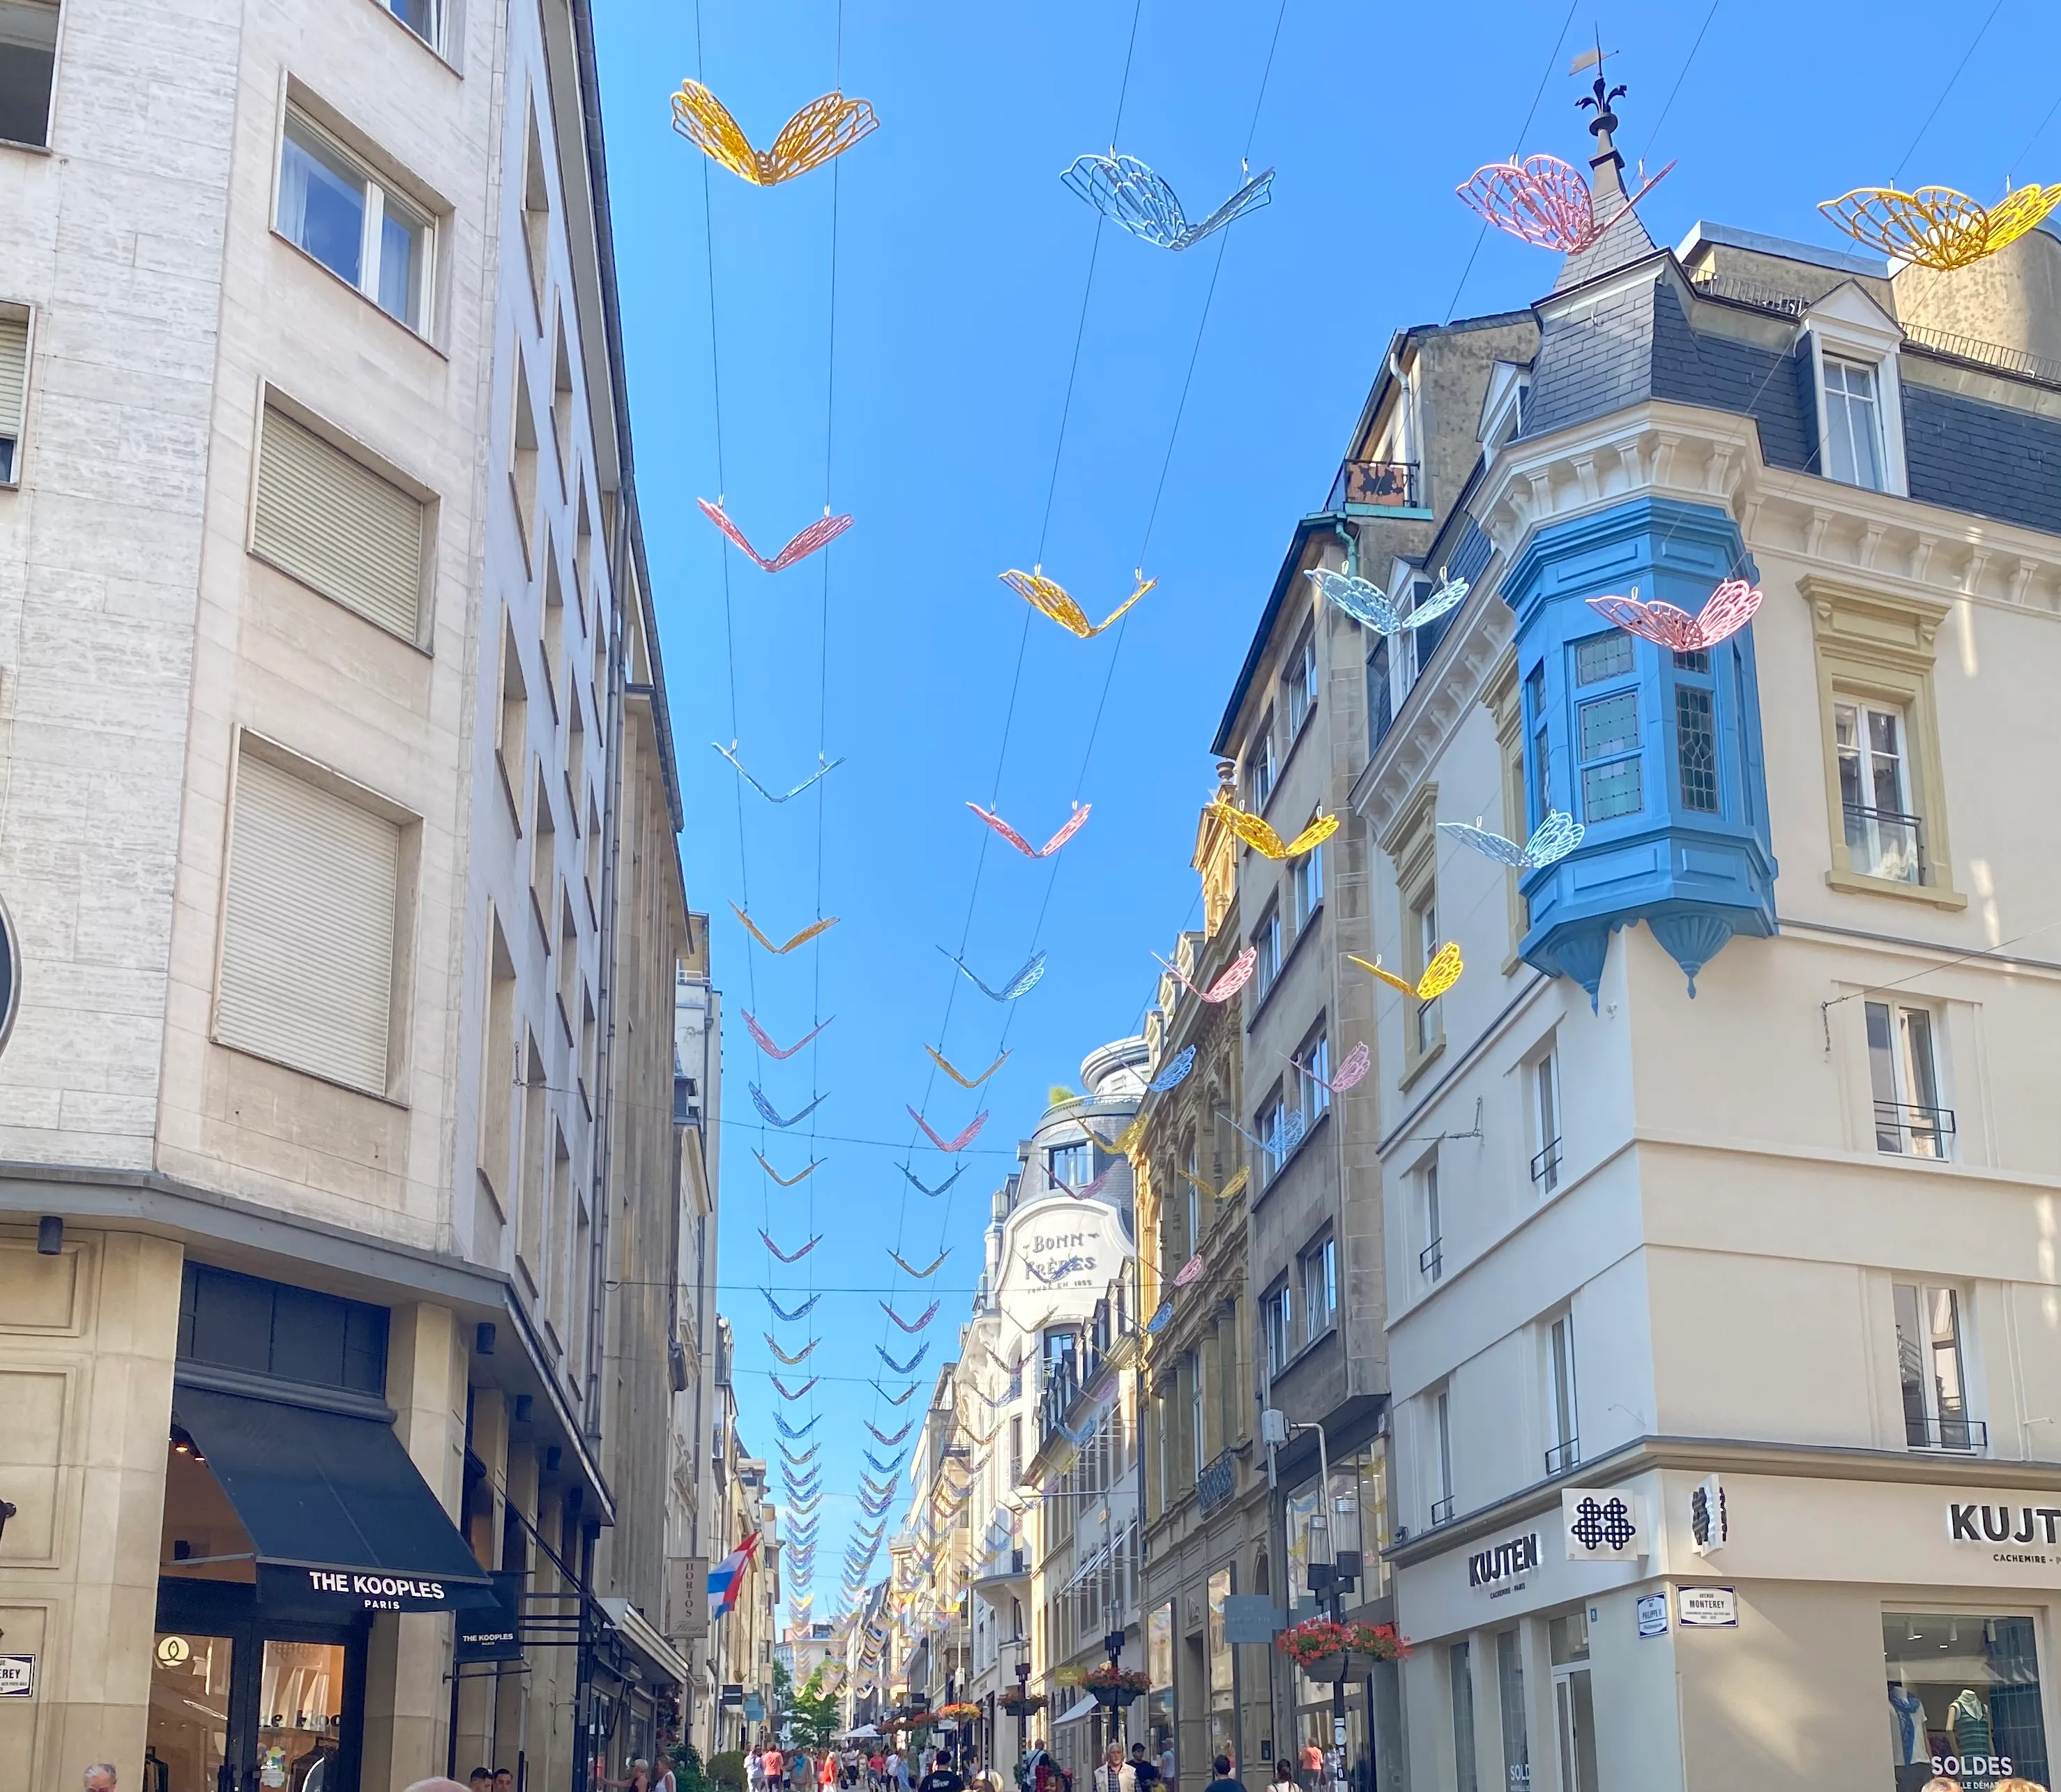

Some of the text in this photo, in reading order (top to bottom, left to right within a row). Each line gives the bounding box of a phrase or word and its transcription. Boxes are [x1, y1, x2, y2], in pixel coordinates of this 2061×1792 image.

[1951, 1504, 2061, 1544] KUJT
[1468, 1533, 1537, 1587] KUJTEN
[1993, 1554, 2046, 1563] CACHEMIRE
[310, 1571, 445, 1600] THE KOOPLES
[685, 1563, 694, 1617] HORTOS
[364, 1600, 400, 1610] PARIS
[1689, 1600, 1725, 1609] MONTEREY
[1931, 1756, 2014, 1776] SOLDES
